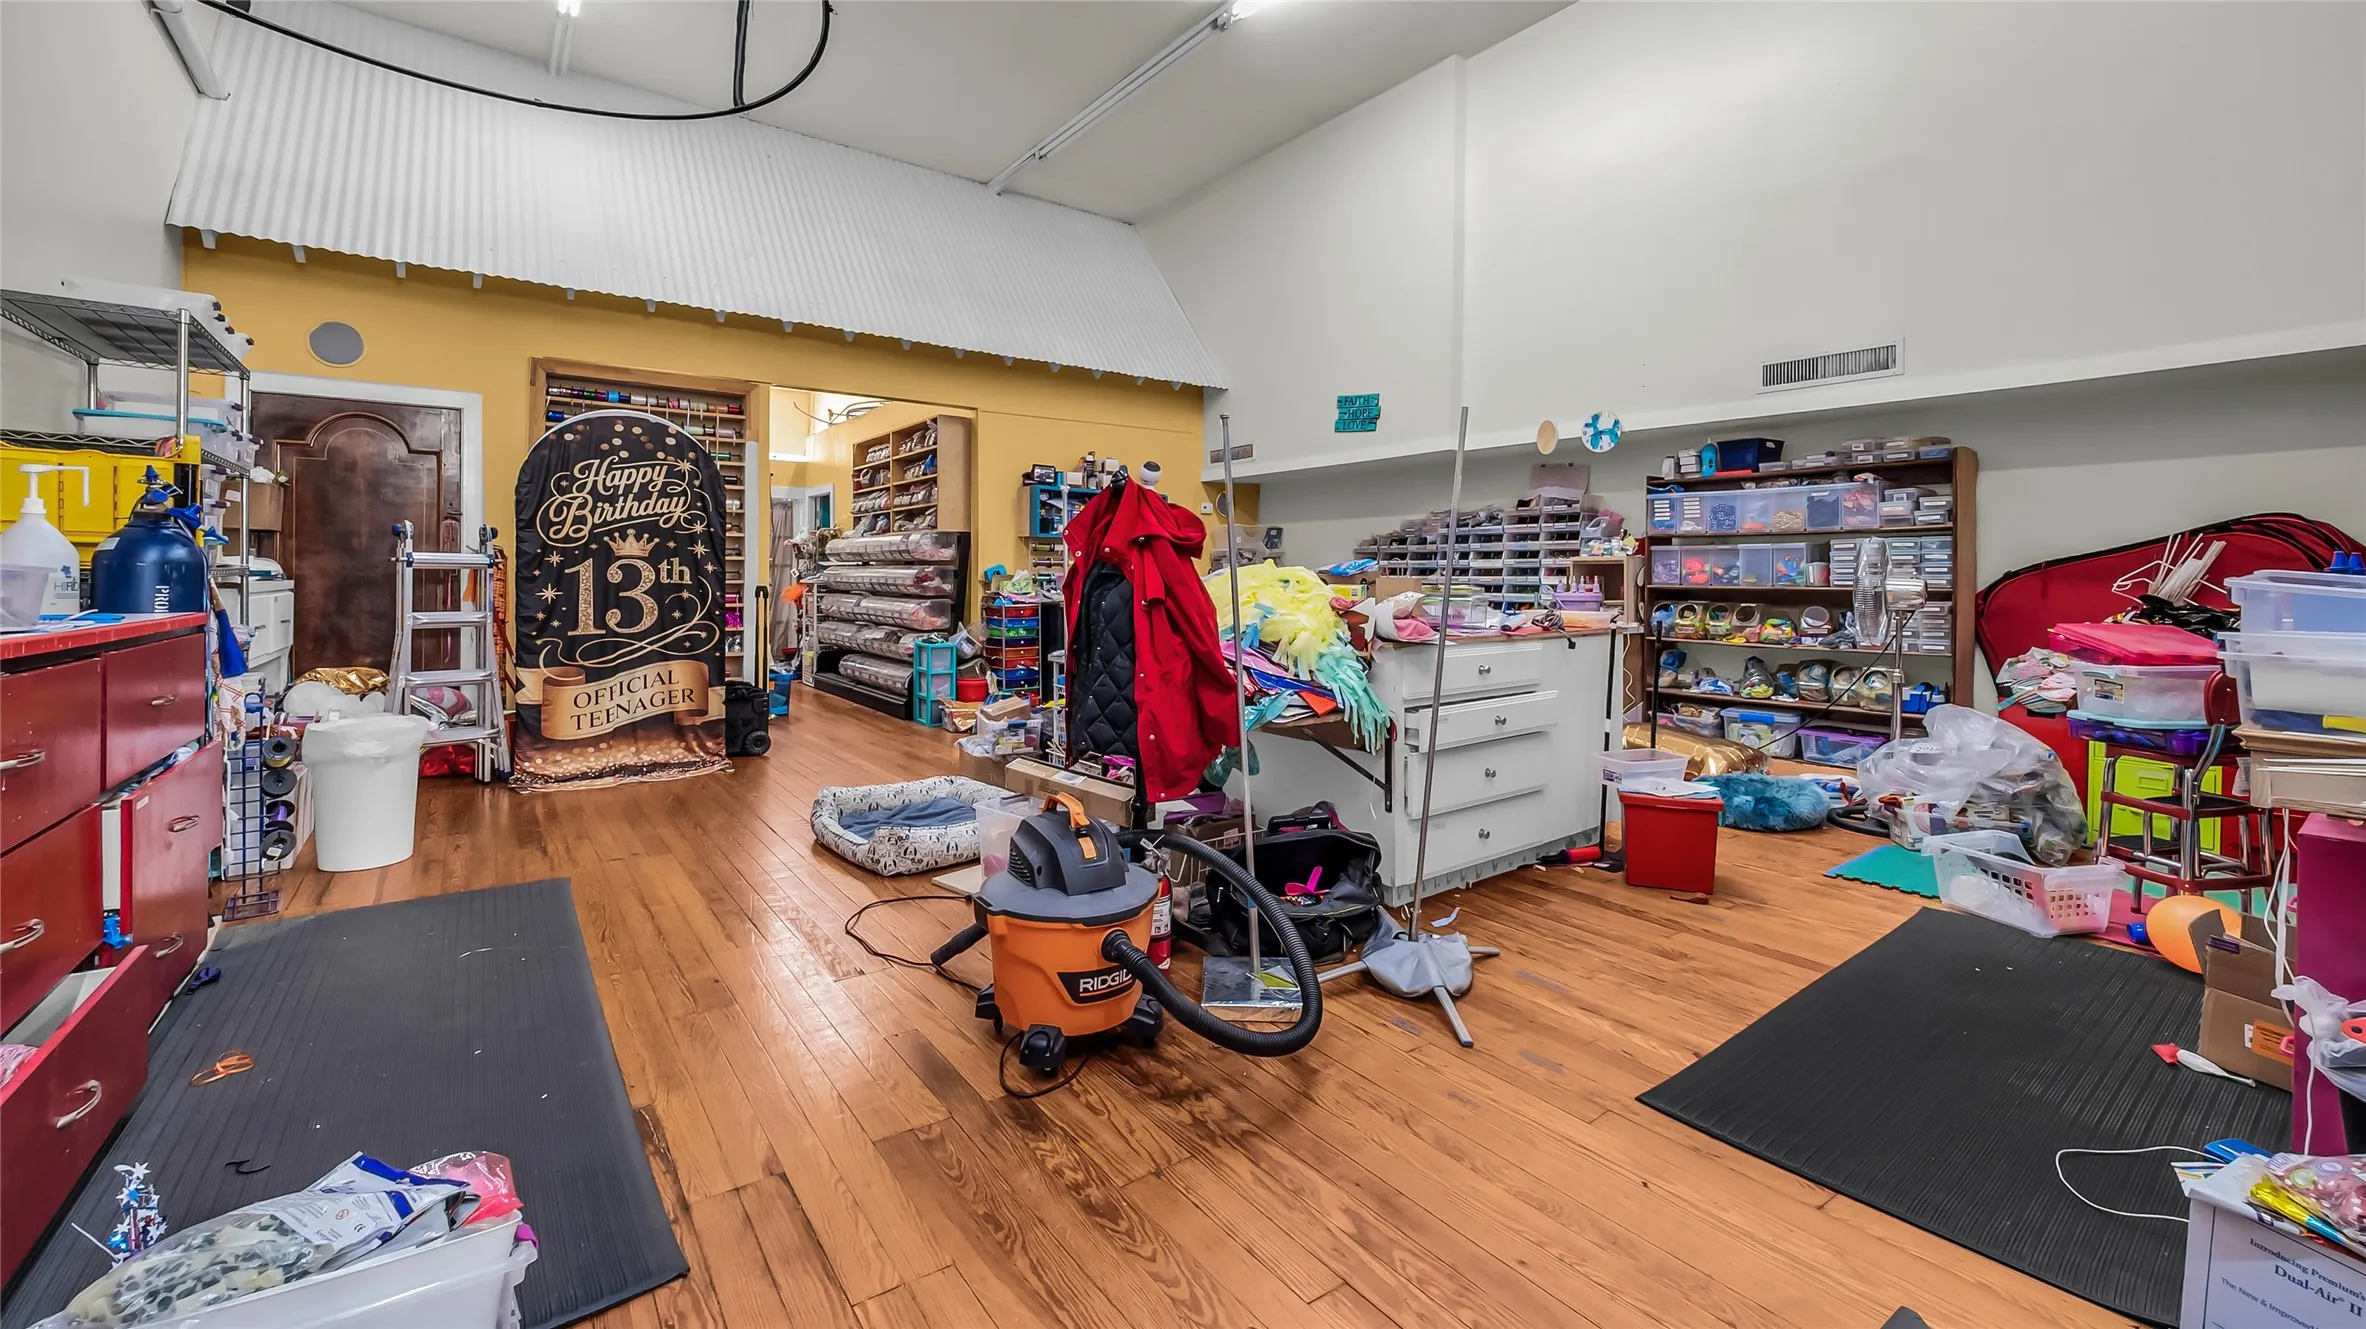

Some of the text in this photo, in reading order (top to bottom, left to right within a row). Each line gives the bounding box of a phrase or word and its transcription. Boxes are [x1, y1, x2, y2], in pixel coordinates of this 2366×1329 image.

[1344, 396, 1370, 406] FAITH
[1348, 408, 1372, 418] HOPE
[1342, 421, 1366, 430] LOVE
[573, 456, 668, 496] Happy
[549, 491, 686, 539] Birthday
[564, 557, 692, 636] 13th
[573, 669, 680, 709] OFFICIAL
[570, 688, 695, 730] TEENAGER
[2250, 1237, 2309, 1275] Introducing
[2221, 1276, 2237, 1291] The
[2239, 1286, 2259, 1302] New
